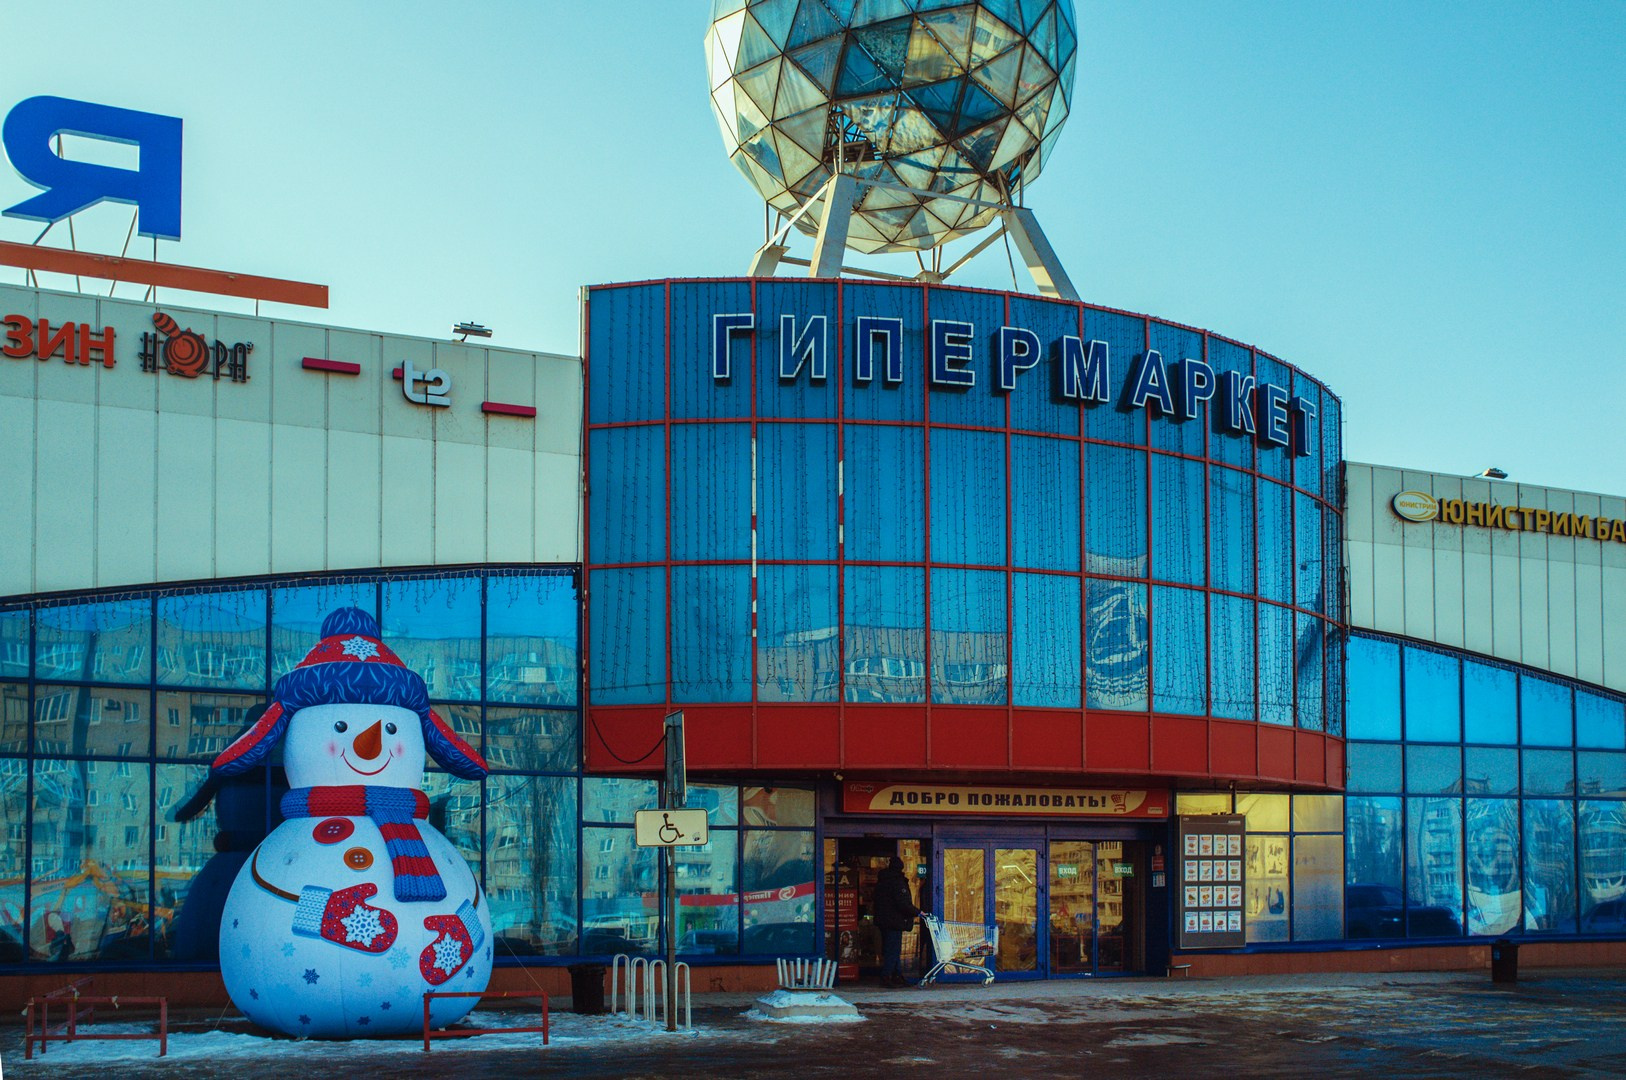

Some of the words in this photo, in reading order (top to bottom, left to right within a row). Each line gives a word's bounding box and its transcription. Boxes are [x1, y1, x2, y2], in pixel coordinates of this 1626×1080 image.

[3, 314, 115, 368] ЗИН
[713, 313, 1316, 456] ГИПЕРМАРКЕТ
[1441, 497, 1591, 537] ЮНИСТРИМ
[1596, 517, 1626, 542] БА
[889, 791, 960, 805] ДОБРО
[967, 792, 1107, 808] ПОЖАЛОВАТЬ!
[1058, 867, 1077, 875] ВХОД
[1114, 866, 1133, 874] ВХОД
